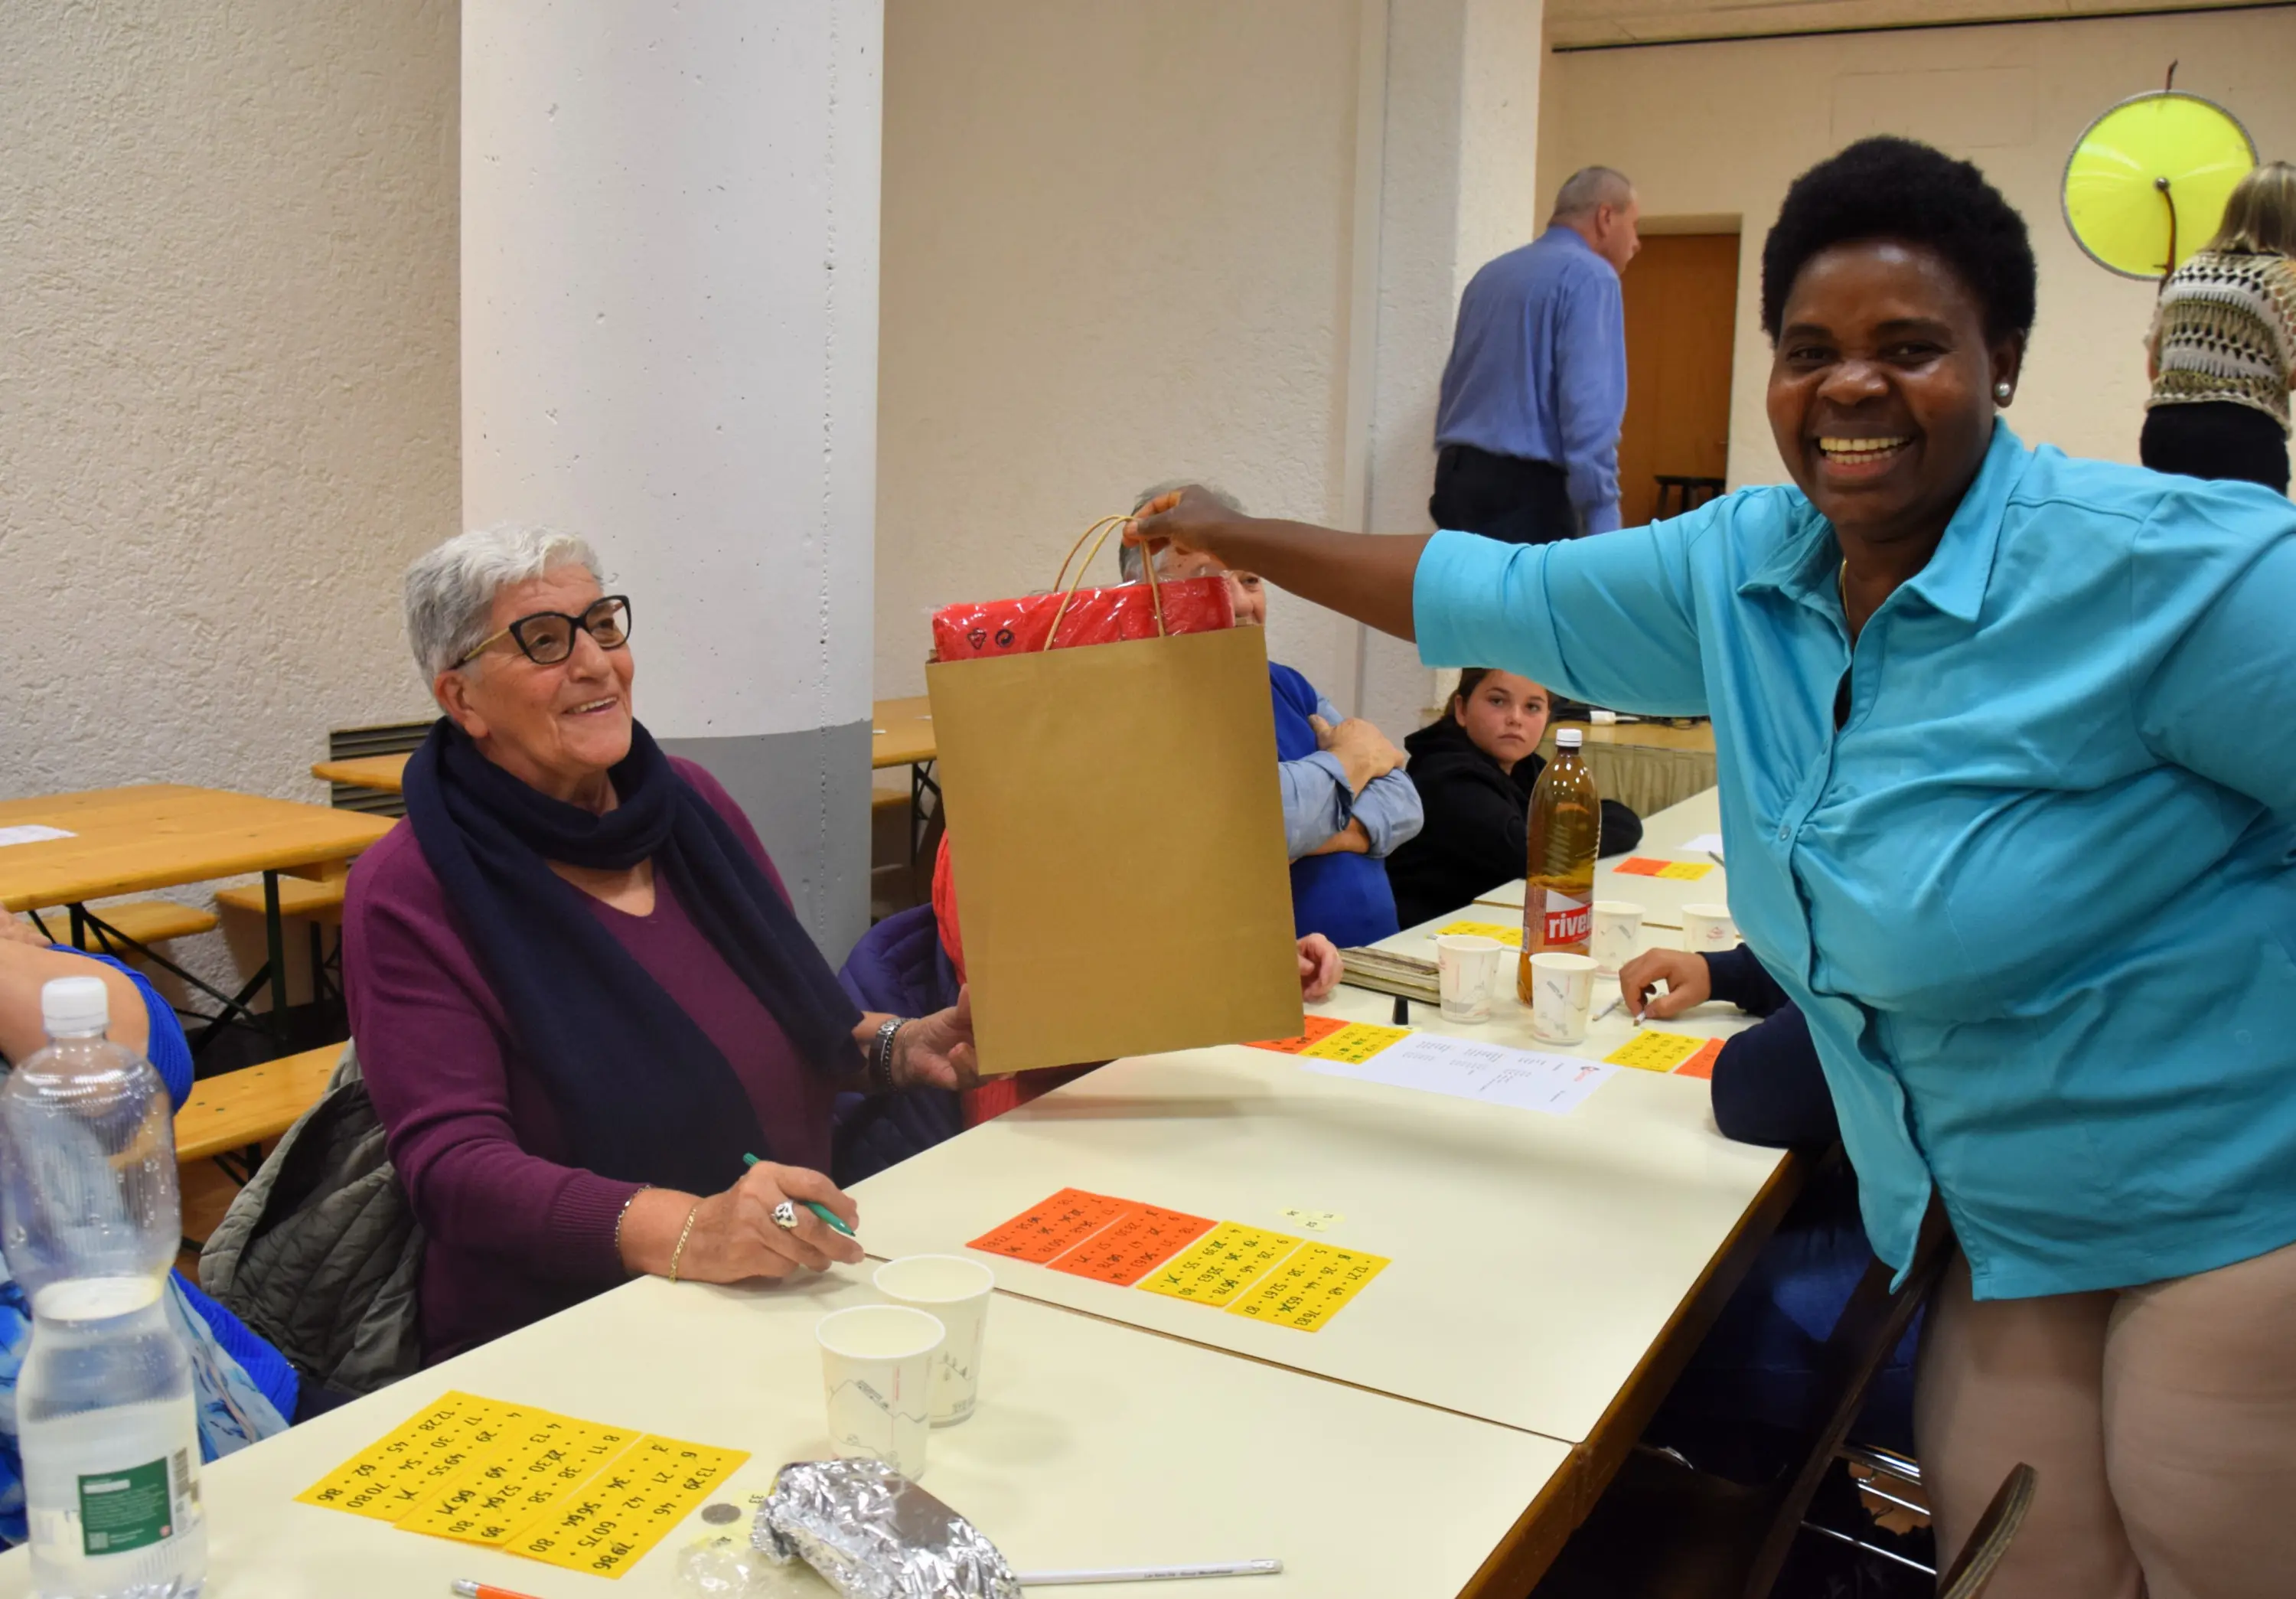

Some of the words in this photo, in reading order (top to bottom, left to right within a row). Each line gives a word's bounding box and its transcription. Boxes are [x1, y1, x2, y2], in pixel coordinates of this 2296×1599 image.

[1257, 1251, 1274, 1259] 28
[1286, 1297, 1303, 1305] 65
[1244, 1306, 1261, 1314] 87
[435, 1411, 455, 1420] 12
[419, 1419, 442, 1431] 28
[464, 1418, 482, 1426] 17
[431, 1437, 452, 1447] 30
[530, 1434, 550, 1443] 13
[386, 1442, 409, 1453] 45
[399, 1460, 422, 1470] 54
[529, 1460, 553, 1472] 30
[427, 1466, 451, 1476] 55
[558, 1467, 582, 1478] 38
[696, 1468, 716, 1477] 13
[652, 1472, 673, 1483] 21
[365, 1483, 390, 1494] 70
[497, 1485, 522, 1496] 52
[347, 1495, 372, 1507] 80
[528, 1491, 553, 1503] 58
[623, 1497, 645, 1509] 42
[654, 1503, 677, 1515] 46
[448, 1521, 475, 1532] 80
[592, 1522, 617, 1535] 60
[529, 1539, 555, 1552] 80
[578, 1535, 602, 1547] 75
